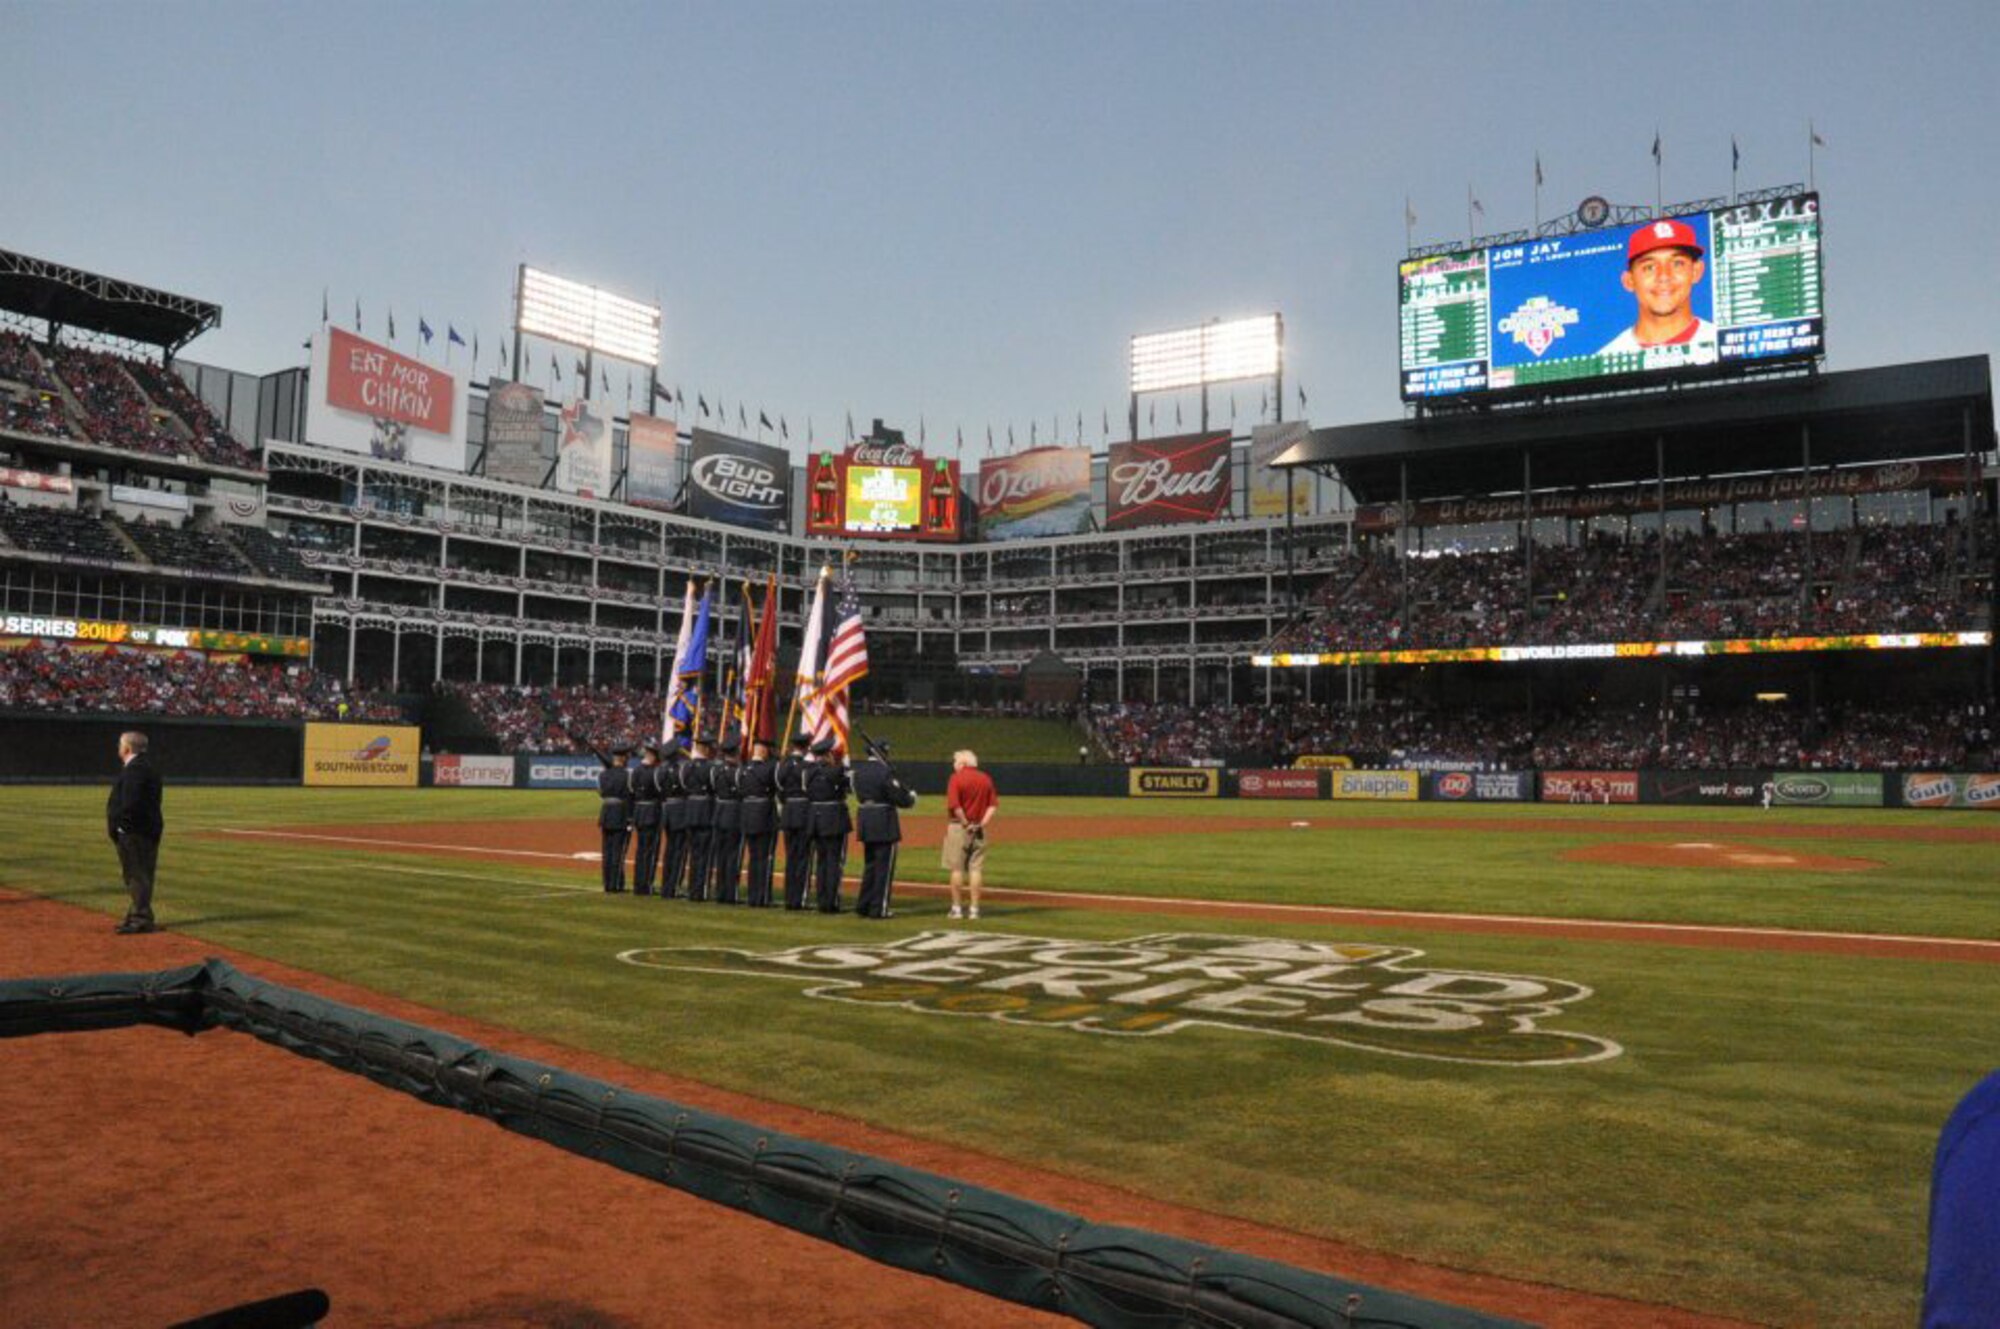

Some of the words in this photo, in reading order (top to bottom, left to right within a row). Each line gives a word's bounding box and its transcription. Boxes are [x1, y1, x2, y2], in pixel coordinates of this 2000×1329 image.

[1493, 247, 1524, 262] JON
[1531, 241, 1561, 255] JAY
[350, 349, 389, 376] EAT
[392, 363, 429, 395] MOR
[361, 379, 432, 420] CHIKIN
[714, 459, 775, 486] BUD
[1112, 455, 1227, 506] Bud
[701, 472, 784, 504] LIGHT
[6, 615, 76, 637] SERIES
[132, 629, 149, 640] ON
[1143, 775, 1205, 789] STANLEY
[1341, 775, 1409, 795] Snapple
[1908, 781, 1953, 801] Gulf
[885, 931, 1548, 1000] WORLD
[758, 948, 1488, 1031] SERIES
